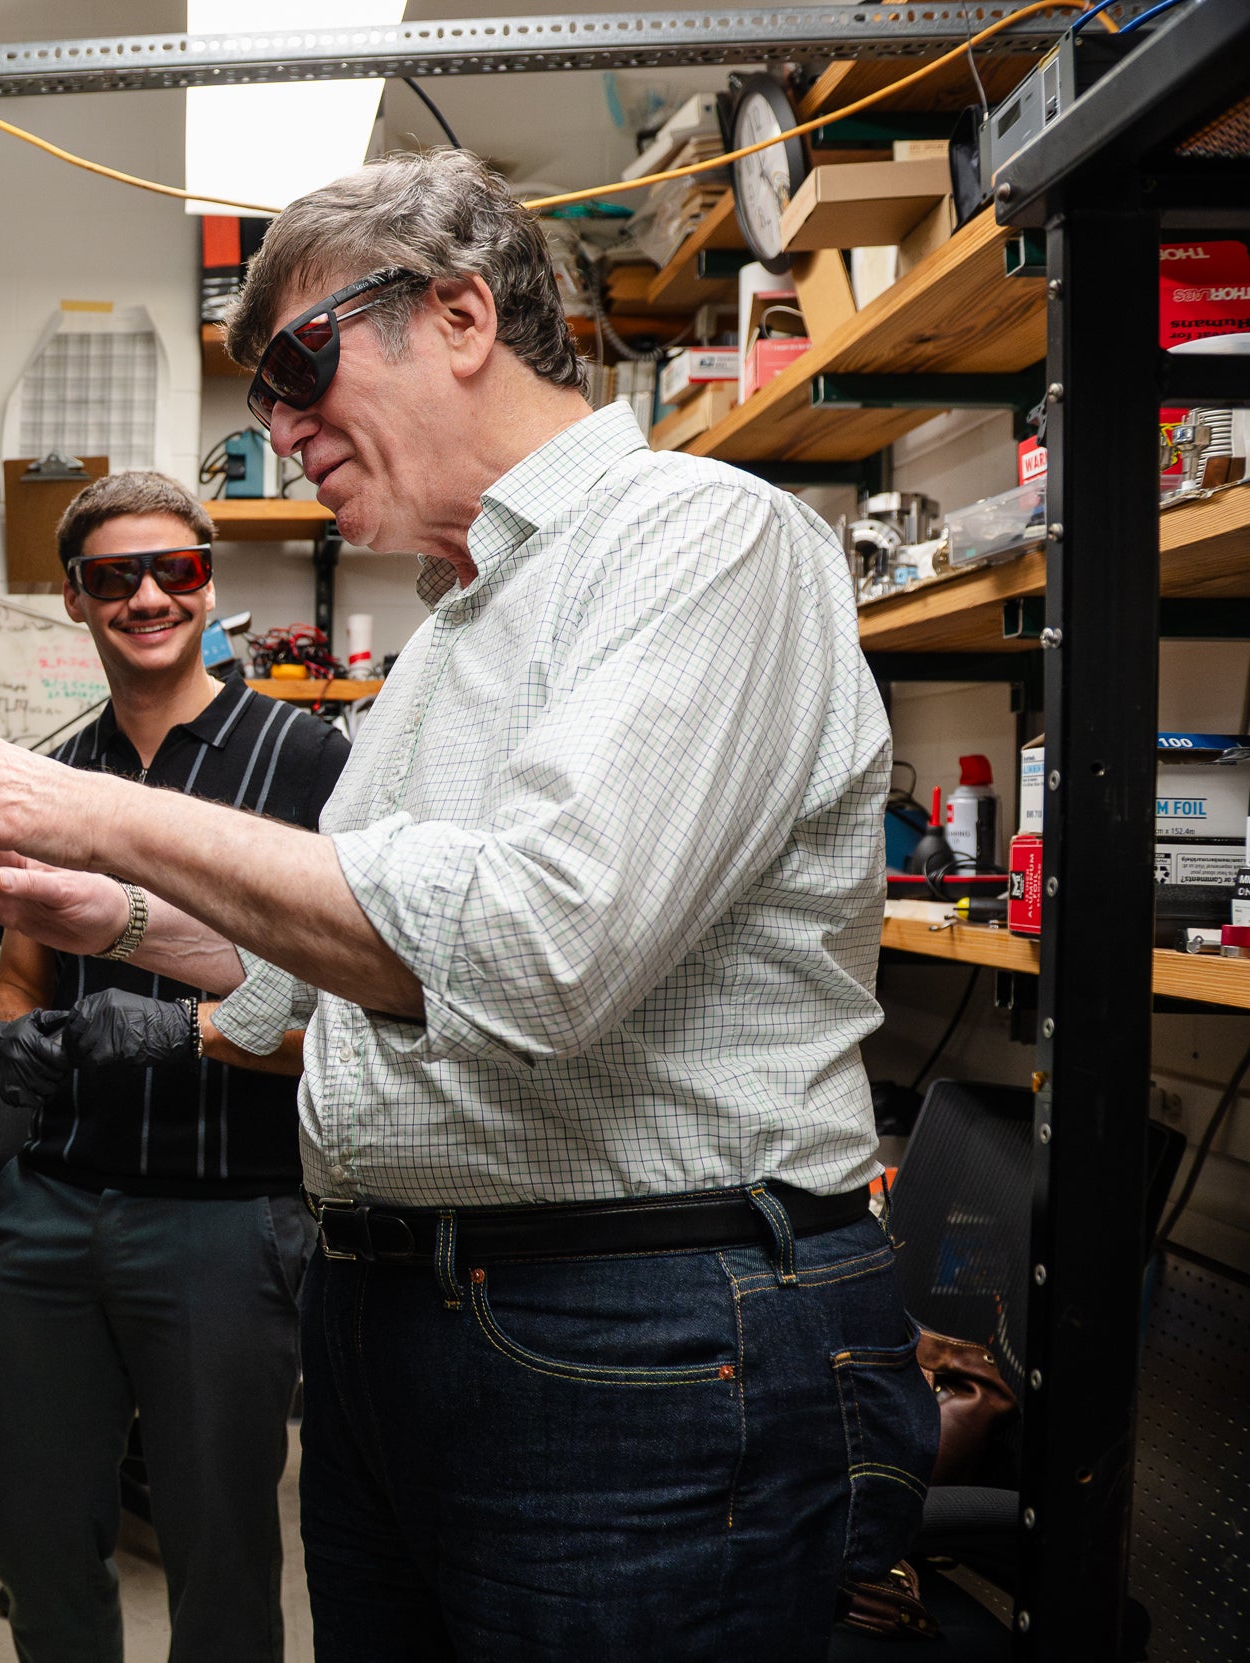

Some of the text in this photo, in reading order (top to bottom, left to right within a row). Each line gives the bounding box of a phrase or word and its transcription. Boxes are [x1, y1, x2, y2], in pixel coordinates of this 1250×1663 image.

[1173, 286, 1250, 303] THORLABS
[1170, 318, 1250, 329] Humans
[1169, 331, 1192, 340] for
[1158, 737, 1193, 748] 100
[1173, 801, 1207, 815] FOIL
[1180, 875, 1223, 884] Comments?
